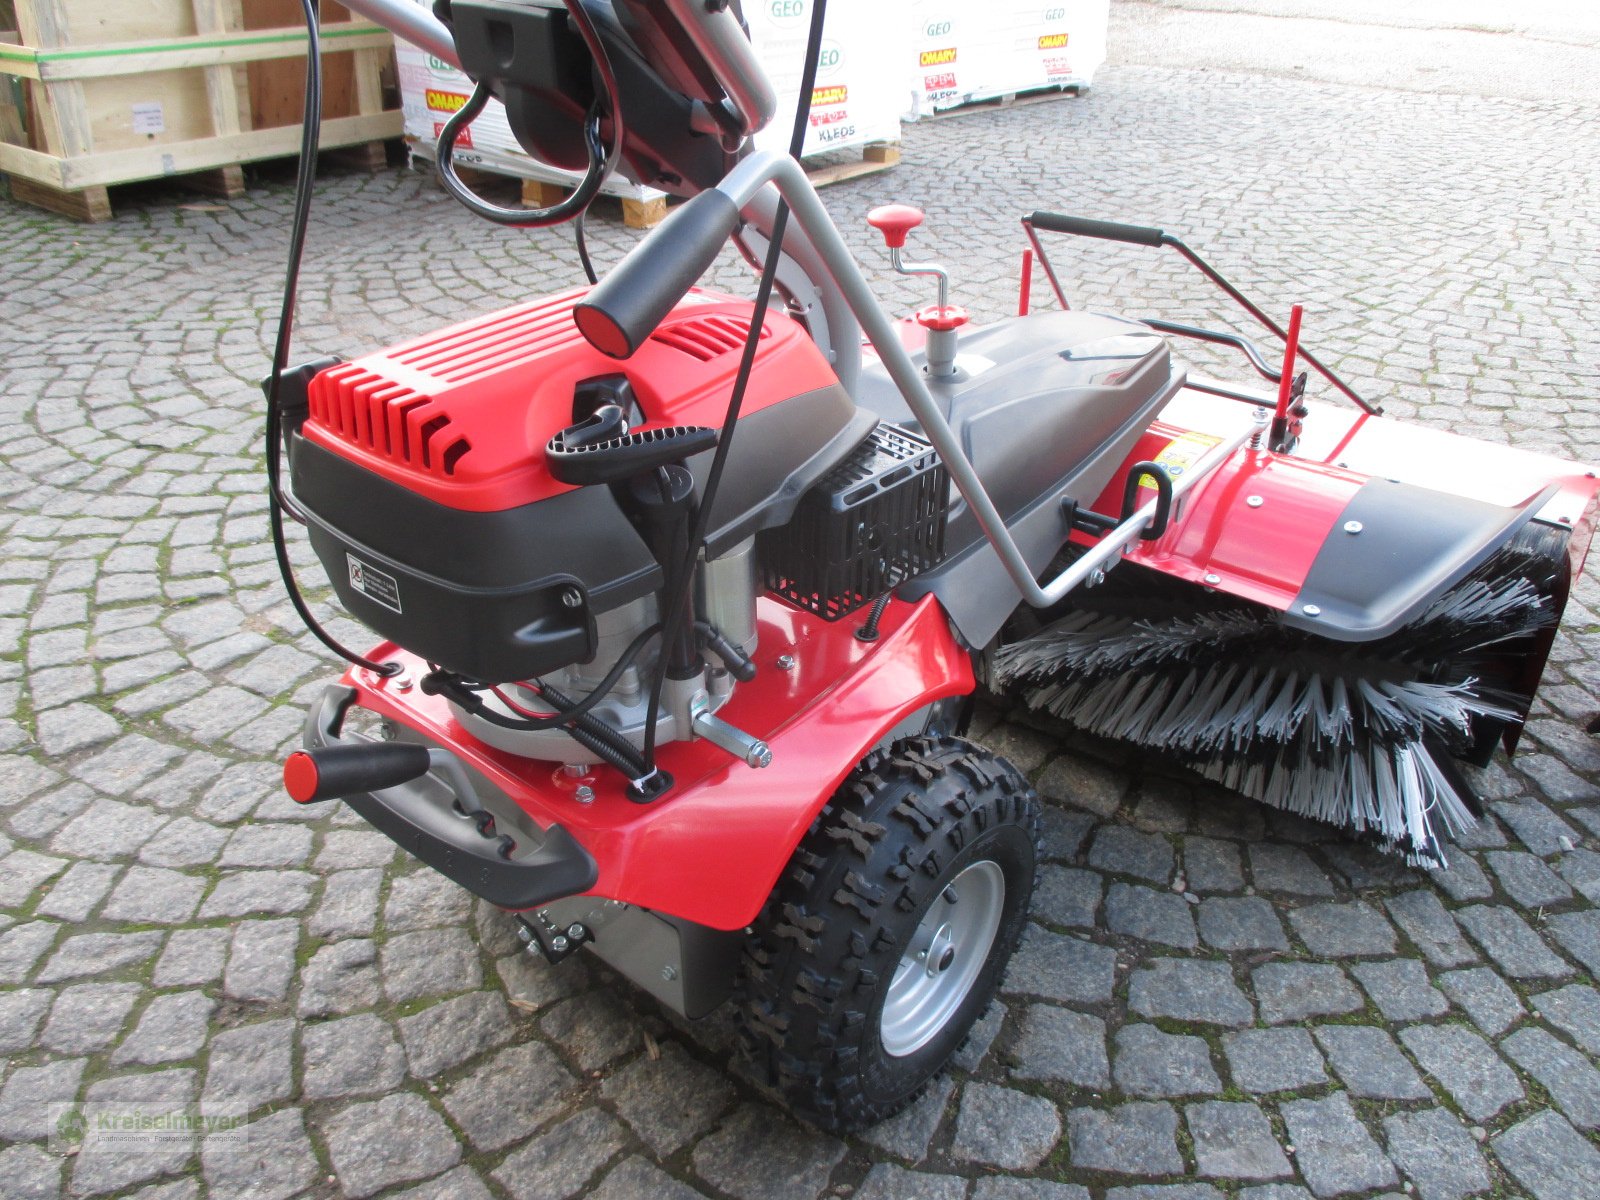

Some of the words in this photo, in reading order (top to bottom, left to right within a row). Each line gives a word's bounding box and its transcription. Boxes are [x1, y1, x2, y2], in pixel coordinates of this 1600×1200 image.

[771, 0, 803, 18] GEO
[1045, 7, 1065, 20] GEO
[927, 21, 951, 37] GEO
[818, 125, 856, 142] KLEOS
